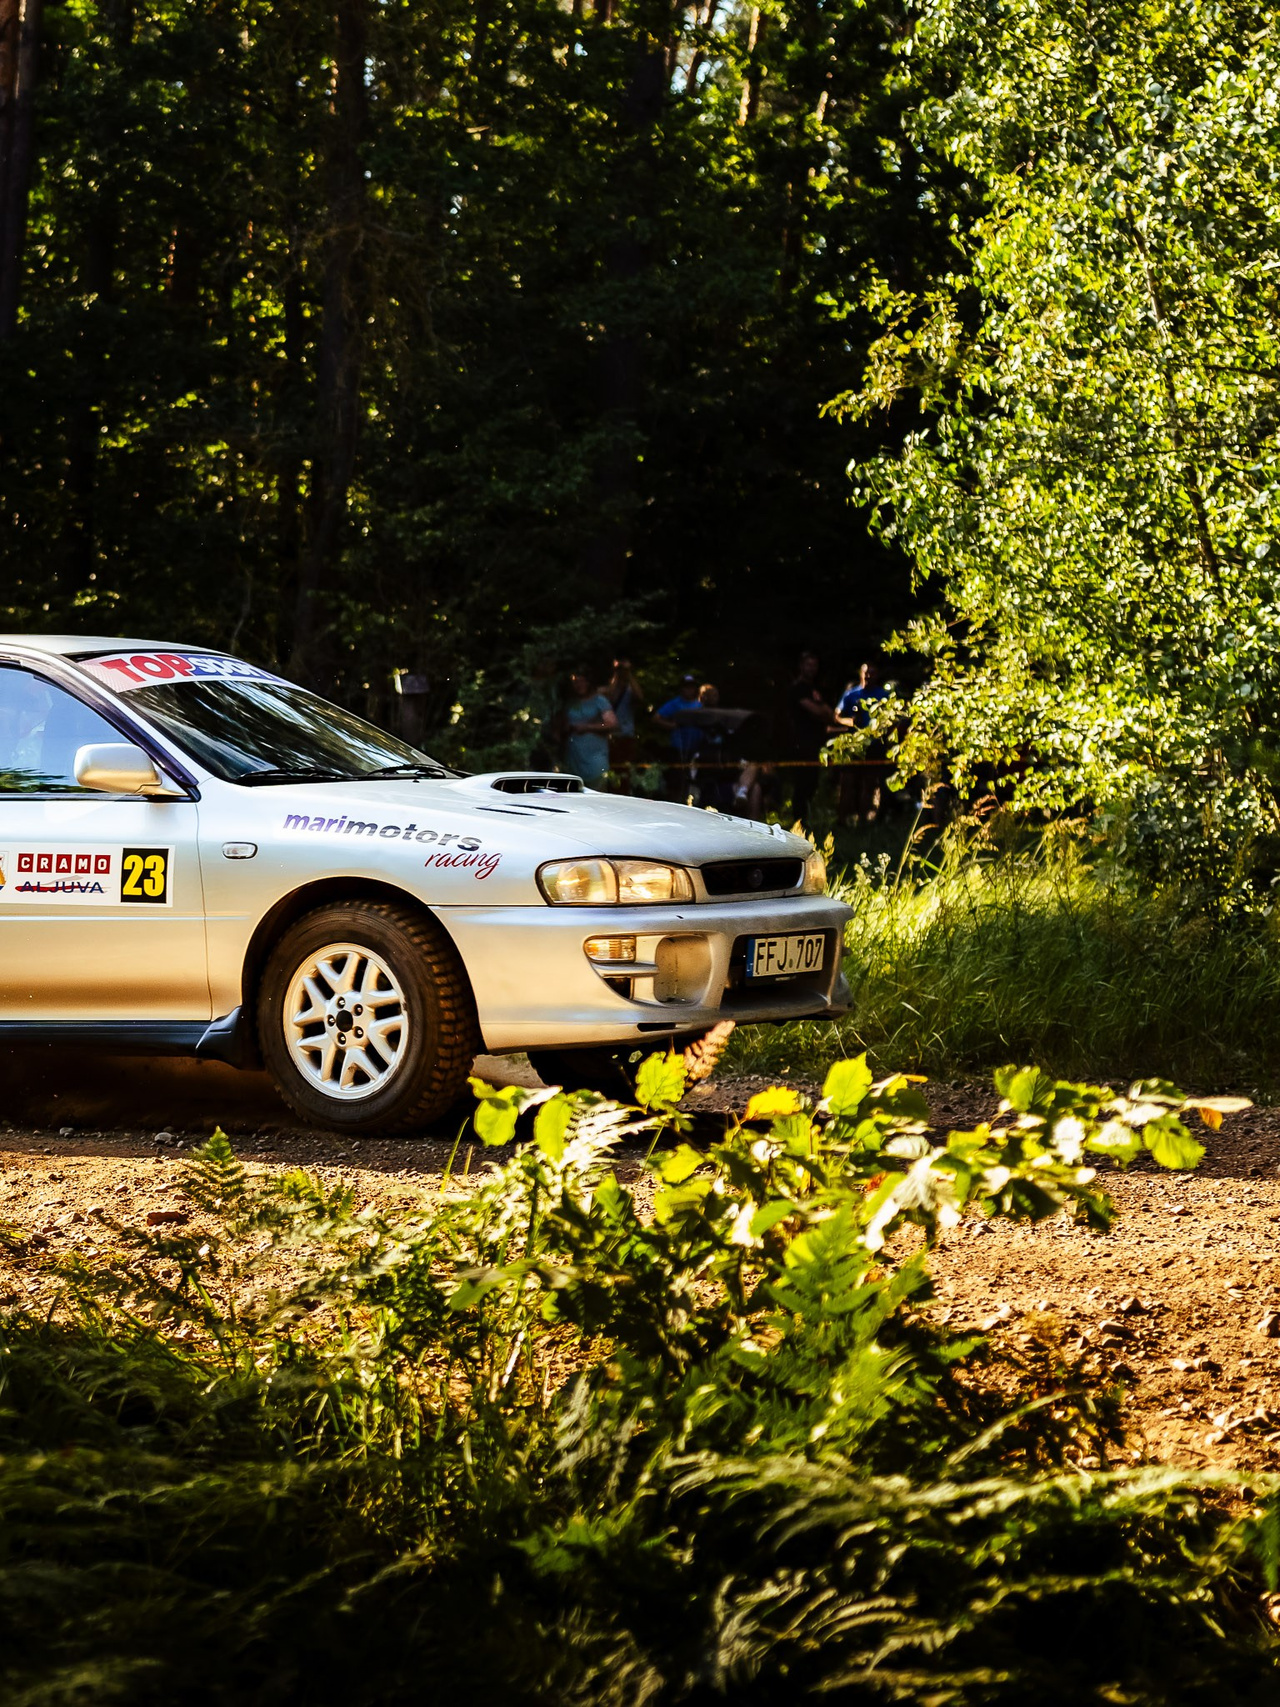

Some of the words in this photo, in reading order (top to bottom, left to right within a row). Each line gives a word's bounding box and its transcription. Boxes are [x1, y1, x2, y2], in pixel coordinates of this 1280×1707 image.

[282, 814, 483, 852] marimotors
[19, 855, 109, 872] CRAMO
[122, 854, 166, 897] 23
[424, 852, 503, 880] racing
[21, 881, 104, 894] ALJUVA
